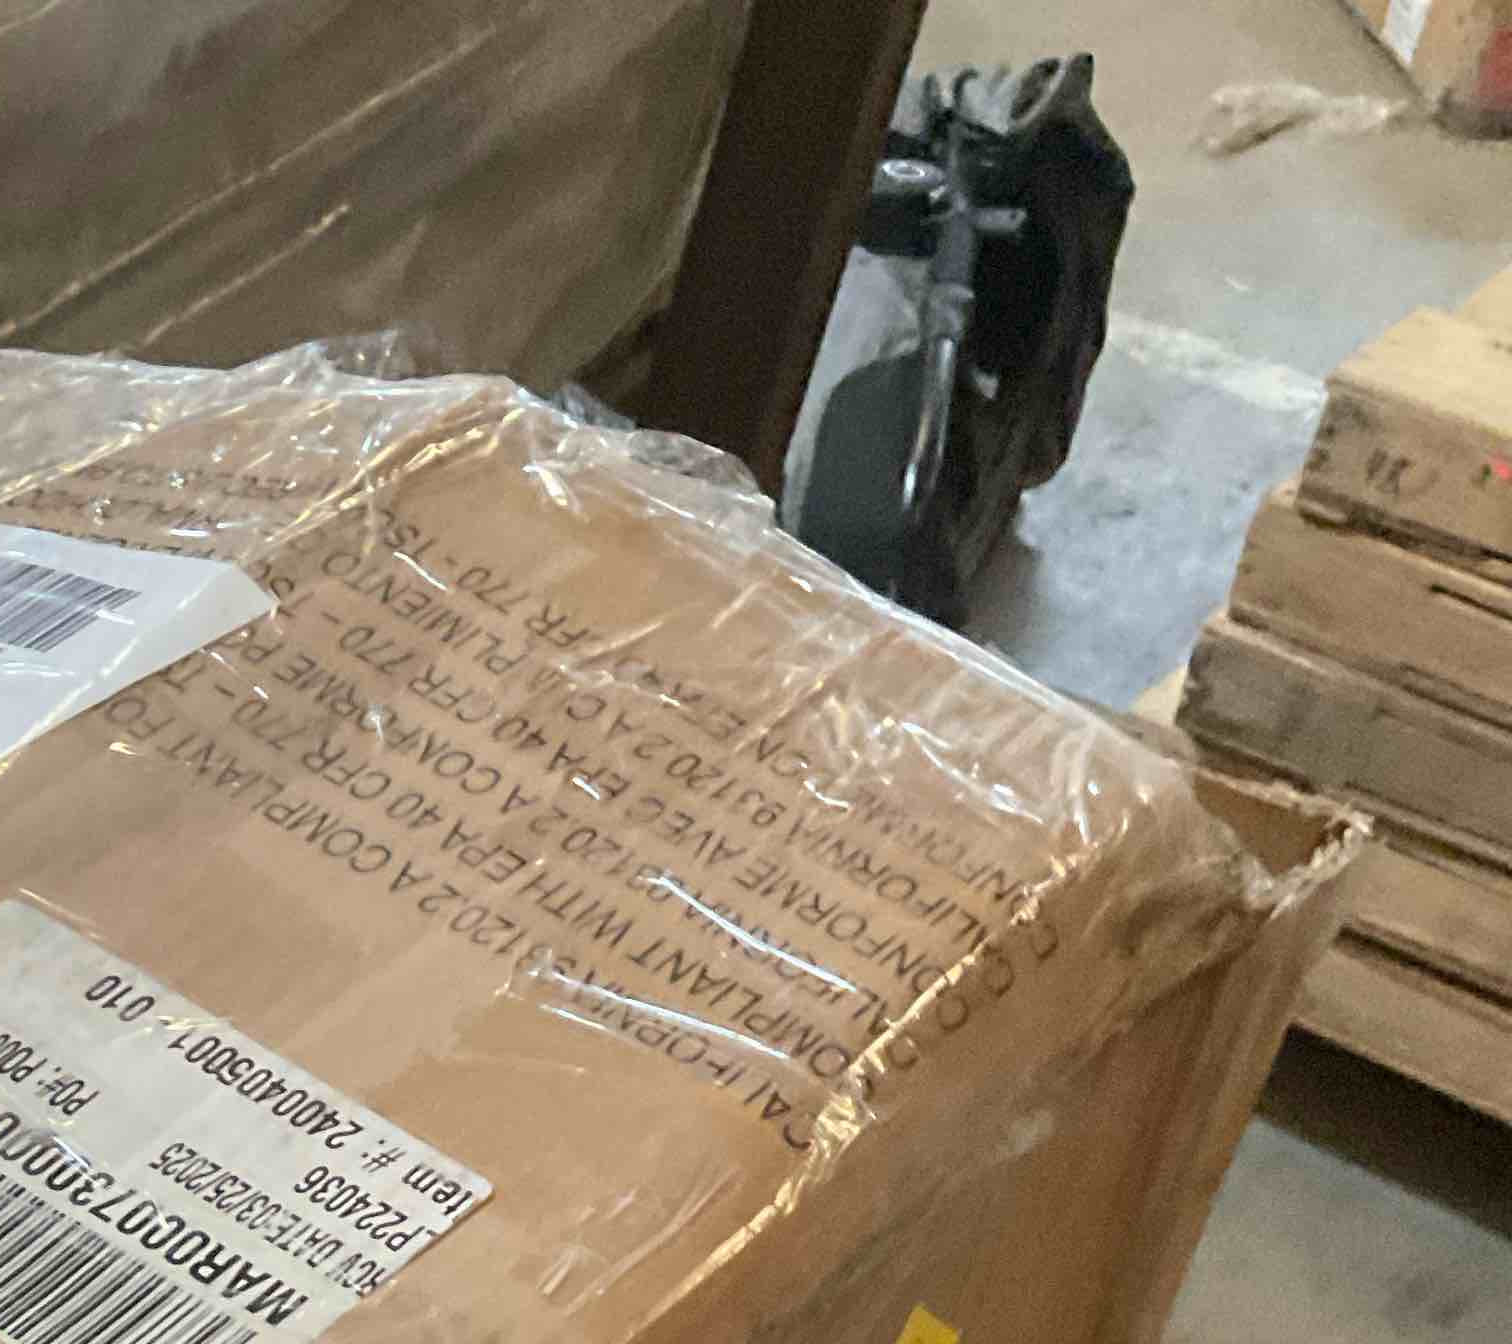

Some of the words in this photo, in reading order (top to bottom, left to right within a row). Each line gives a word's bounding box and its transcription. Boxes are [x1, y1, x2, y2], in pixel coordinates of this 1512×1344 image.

[445, 565, 534, 618] 770
[330, 621, 421, 677] 770
[94, 688, 176, 741] FO
[222, 694, 314, 752] 770
[399, 662, 503, 727] CFR
[271, 653, 509, 798] CONFORME
[486, 712, 558, 757] 40
[293, 736, 398, 804] CFR
[154, 723, 400, 881] COMPLIANT
[380, 788, 452, 835] 40
[488, 782, 541, 818] A
[428, 817, 529, 884] EPA
[619, 792, 748, 872] AVEC
[377, 860, 433, 898] A
[516, 867, 640, 948] WITH
[729, 855, 980, 1034] CONFORME
[80, 973, 161, 1025] 010
[142, 1139, 345, 1265] DATE:03/25/2025
[396, 1162, 476, 1220] tem
